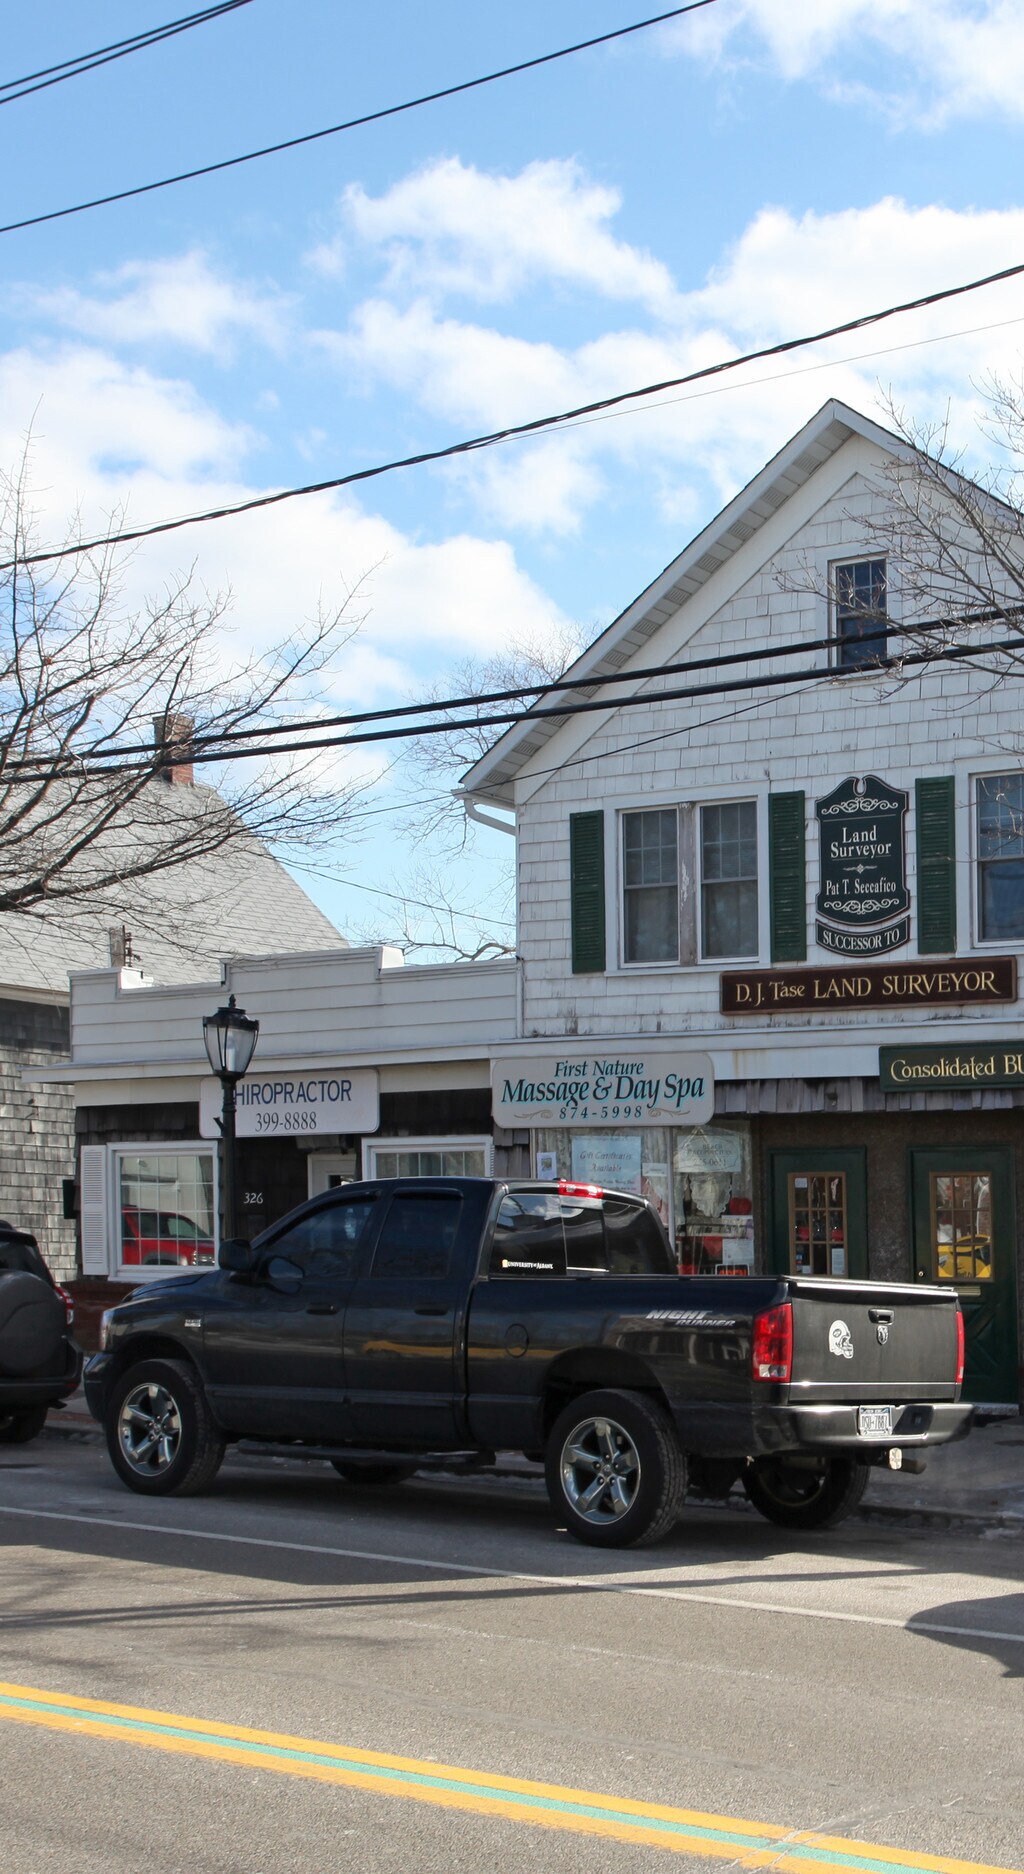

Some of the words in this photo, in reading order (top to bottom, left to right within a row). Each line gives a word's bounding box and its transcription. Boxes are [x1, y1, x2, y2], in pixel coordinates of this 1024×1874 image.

[842, 825, 877, 844] Land
[830, 842, 892, 859] Surveyor
[826, 880, 839, 896] Pat
[842, 879, 851, 895] T.
[854, 876, 896, 894] Seccafico
[822, 929, 883, 950] SUCCESSOR
[884, 927, 900, 946] TO
[736, 984, 752, 1003] D.
[754, 983, 765, 1006] J.
[769, 981, 805, 1000] Tase
[813, 977, 871, 999] LAND
[882, 971, 1001, 996] SURVEYOR
[554, 1060, 588, 1077] First
[592, 1060, 644, 1076] Nature
[890, 1055, 996, 1082] Consolidated
[234, 1079, 352, 1106] HIROPRACTOR
[500, 1078, 590, 1107] Massage
[592, 1077, 612, 1101] &
[615, 1075, 661, 1109] Day
[664, 1073, 705, 1108] Spa
[255, 1111, 317, 1132] 399-8888
[559, 1106, 642, 1120] 874-5998
[243, 1192, 264, 1204] 326
[645, 1310, 713, 1319] NIGHT
